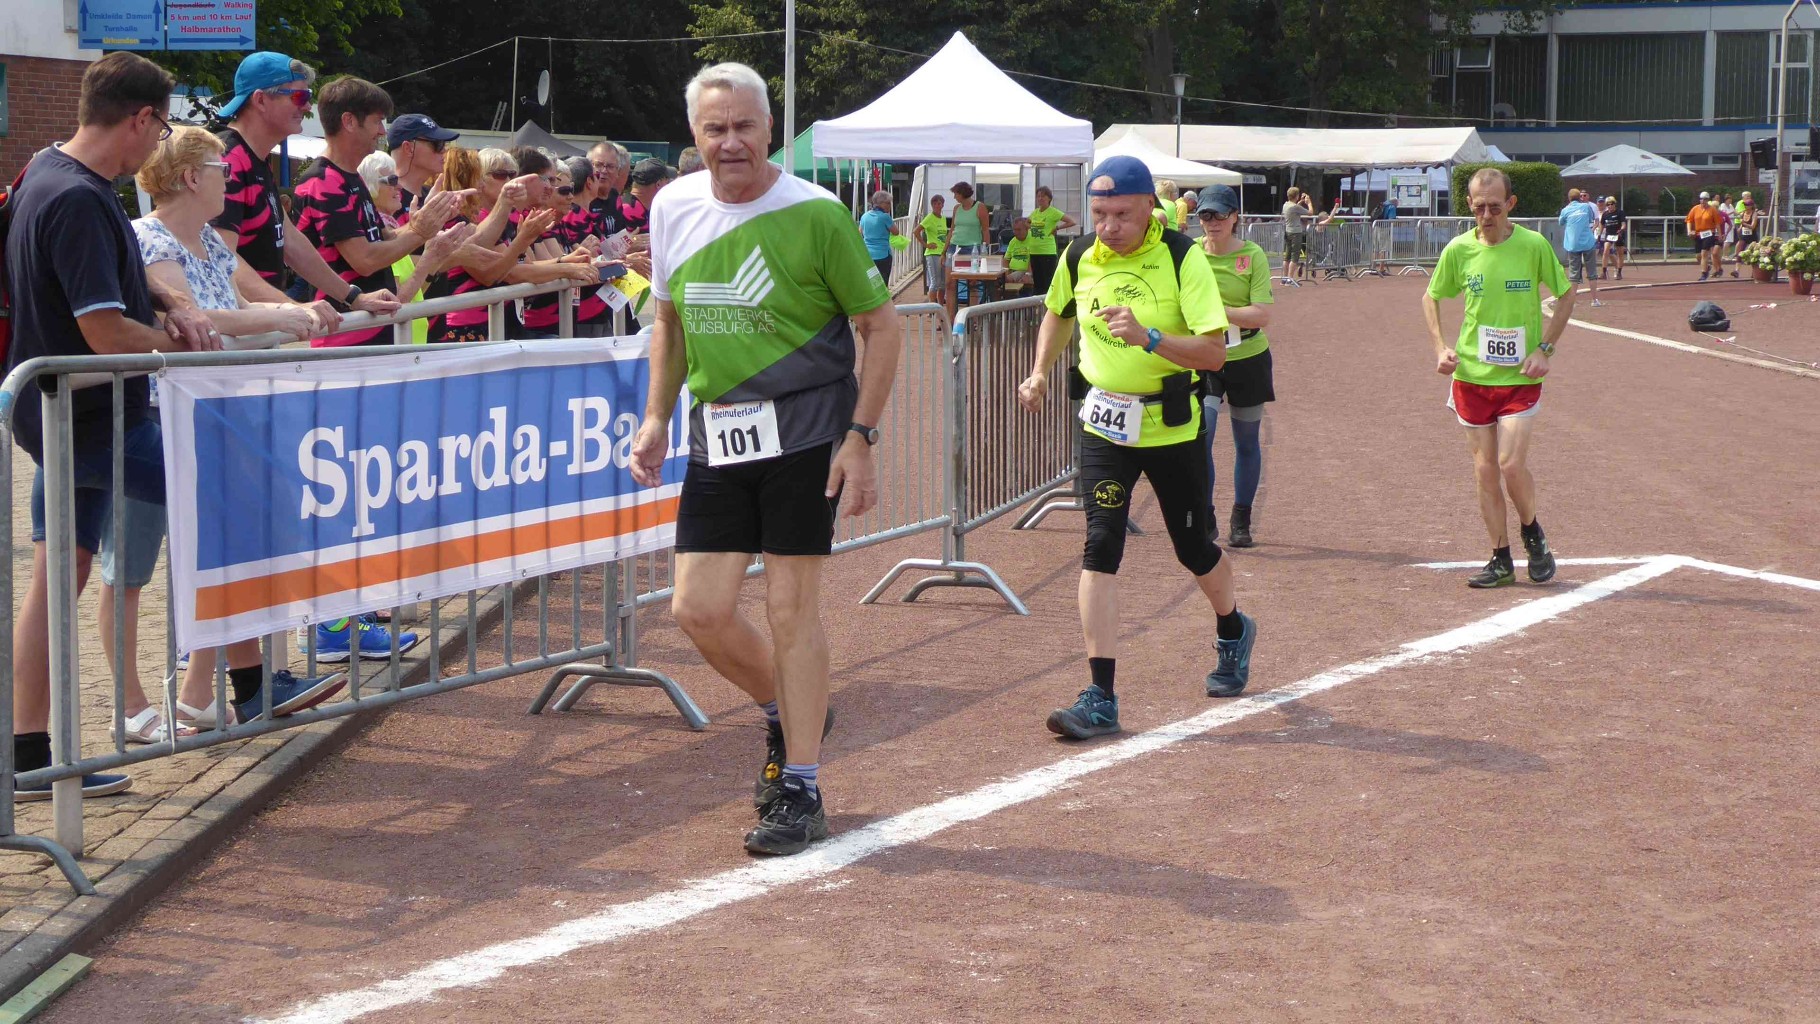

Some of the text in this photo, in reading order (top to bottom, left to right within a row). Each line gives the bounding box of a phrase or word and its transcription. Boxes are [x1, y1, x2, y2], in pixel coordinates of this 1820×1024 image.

[684, 308, 775, 322] STADTWERKE
[757, 322, 776, 334] AG
[1488, 340, 1516, 356] 668
[711, 402, 762, 420] Rheinuferlauf
[1090, 404, 1126, 432] 644
[718, 425, 761, 457] 101
